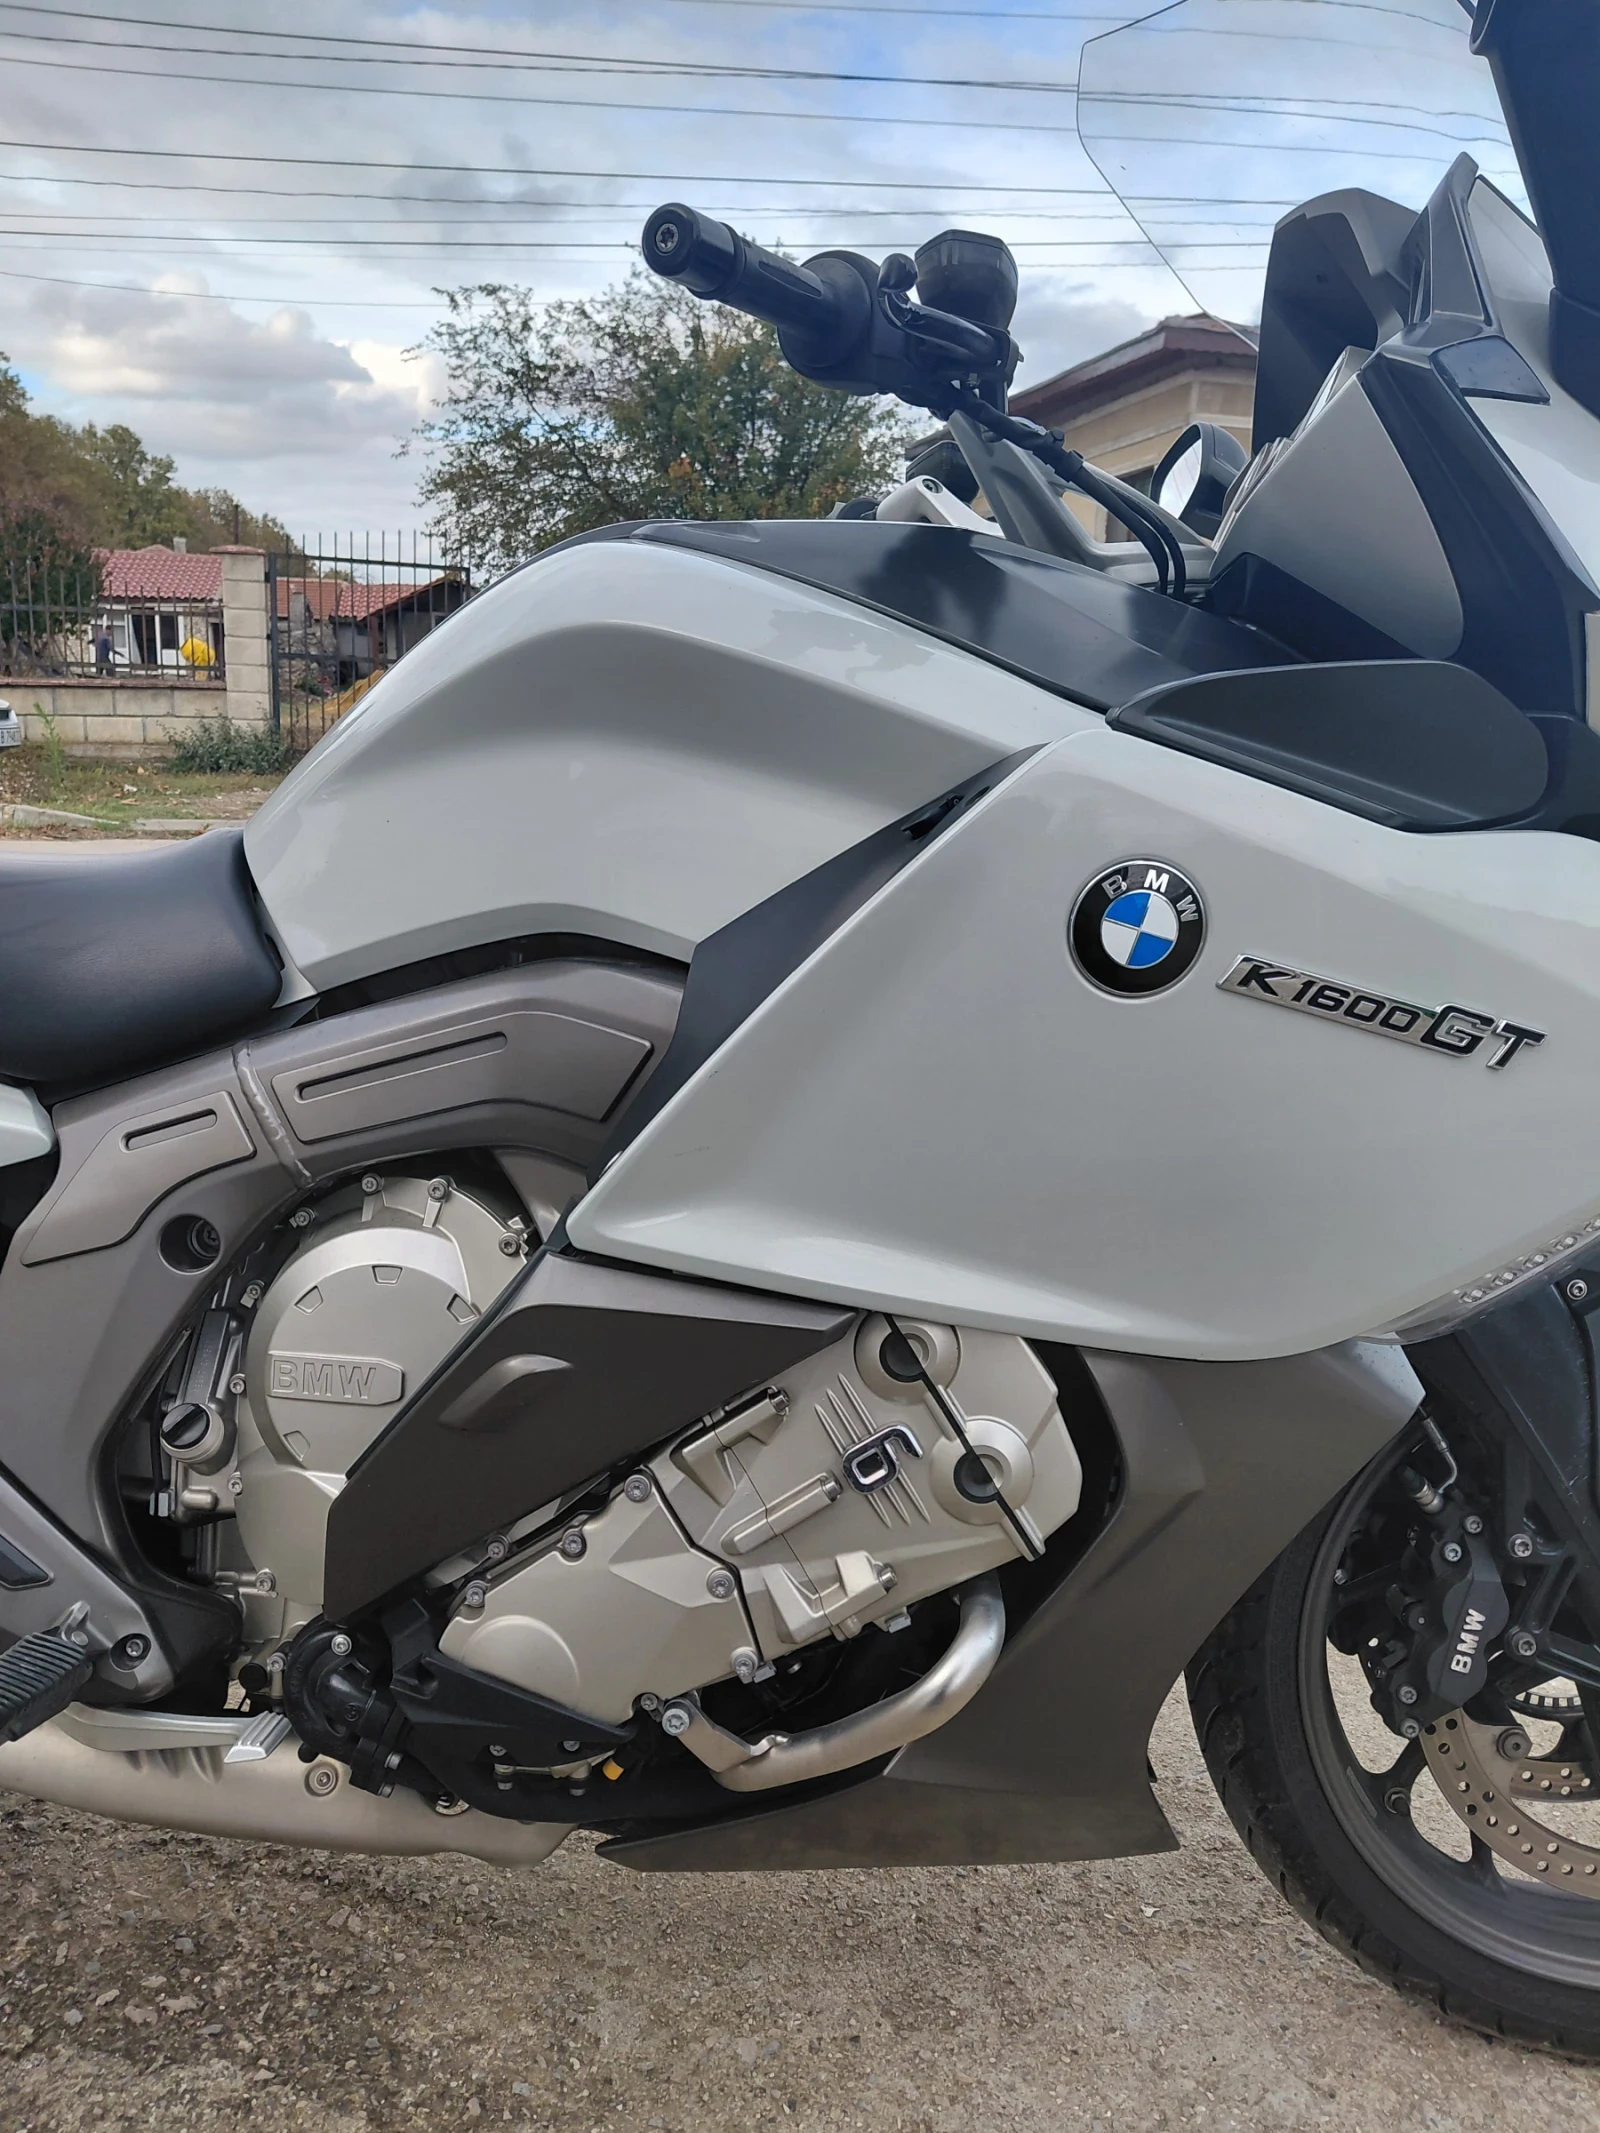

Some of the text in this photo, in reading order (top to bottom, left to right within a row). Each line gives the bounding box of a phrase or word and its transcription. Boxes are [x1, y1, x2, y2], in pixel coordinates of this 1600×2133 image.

[1102, 868, 1199, 923] BMW
[272, 1359, 377, 1400] BMW
[1450, 1608, 1486, 1674] BMW
